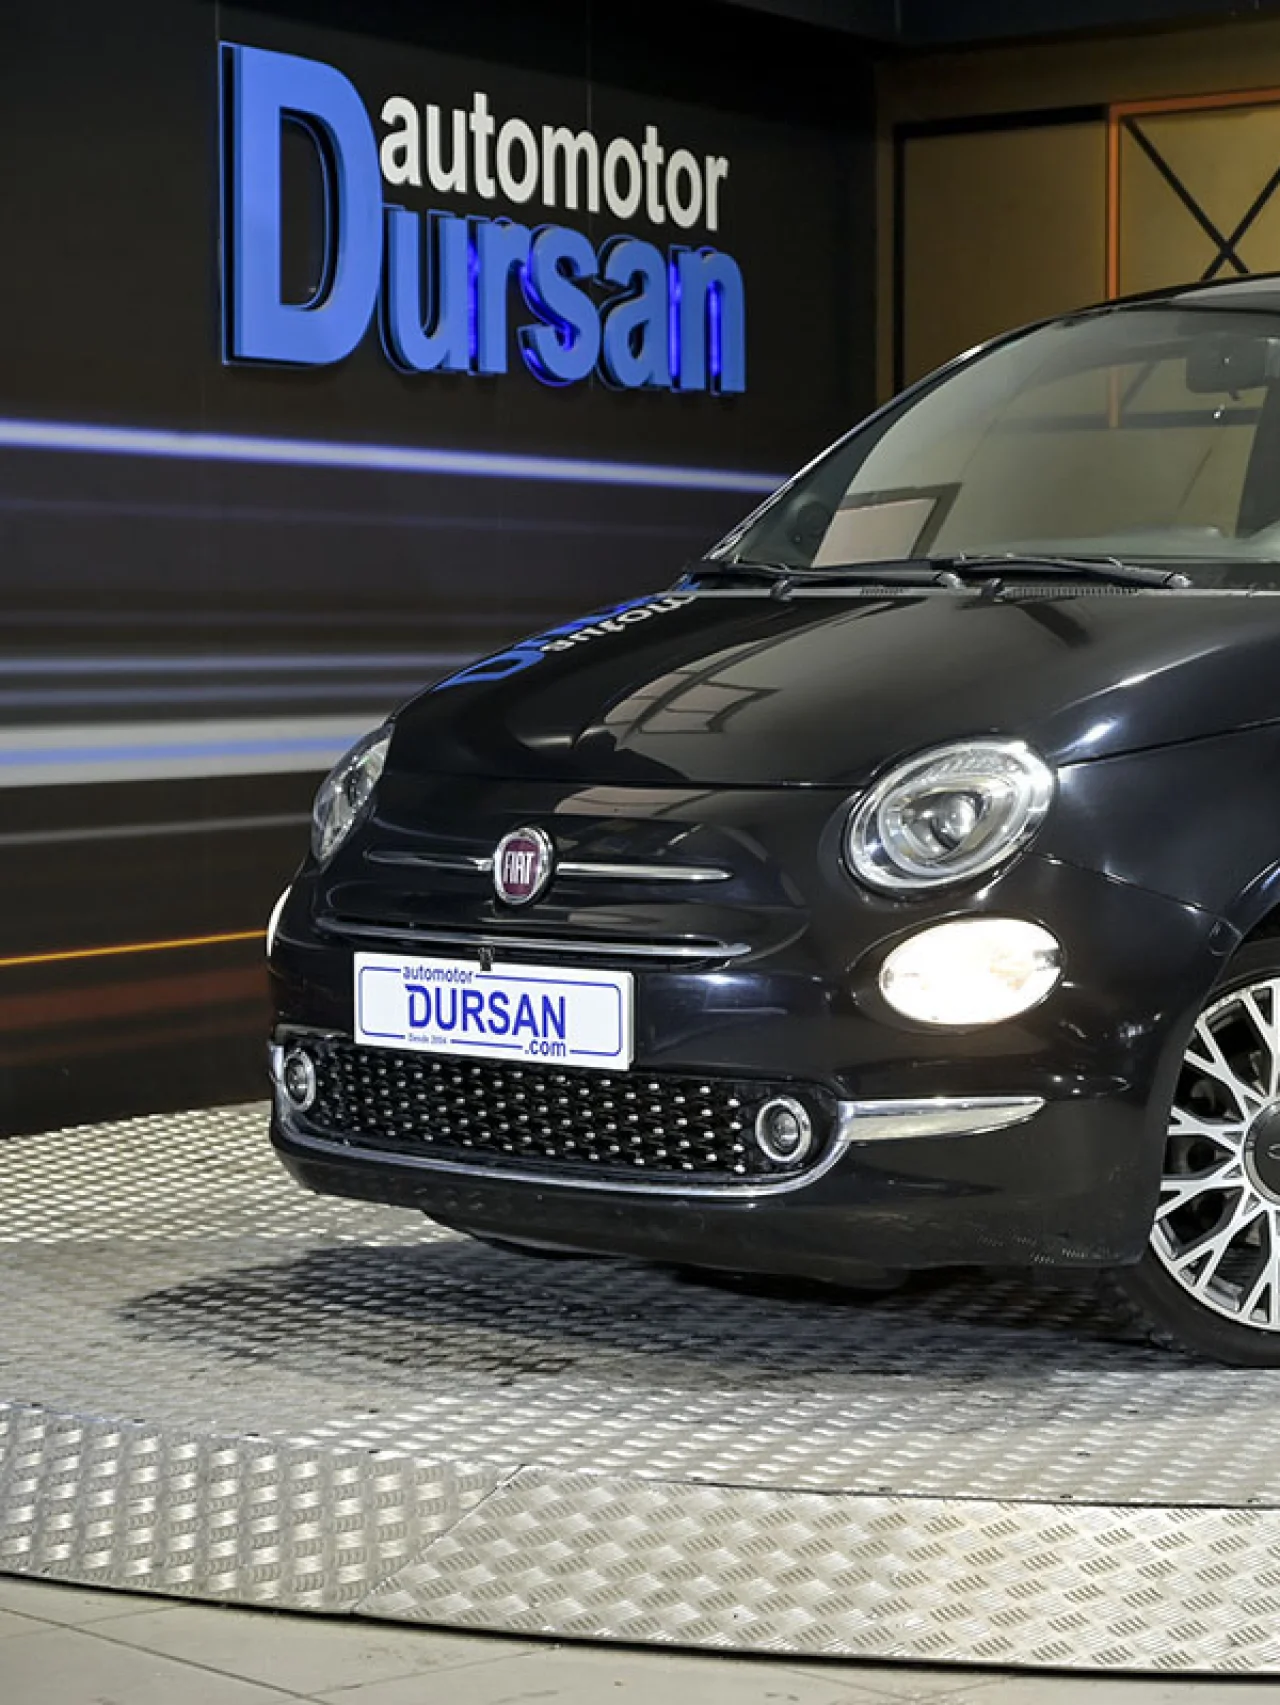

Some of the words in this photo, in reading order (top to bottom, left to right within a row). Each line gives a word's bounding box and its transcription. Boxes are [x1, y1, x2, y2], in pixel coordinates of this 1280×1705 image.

[380, 92, 729, 231] automotor
[219, 40, 747, 396] Dursan
[503, 850, 536, 885] FIAT
[402, 964, 475, 985] automotor
[405, 983, 566, 1040] DURSAN
[525, 1039, 567, 1057] .com
